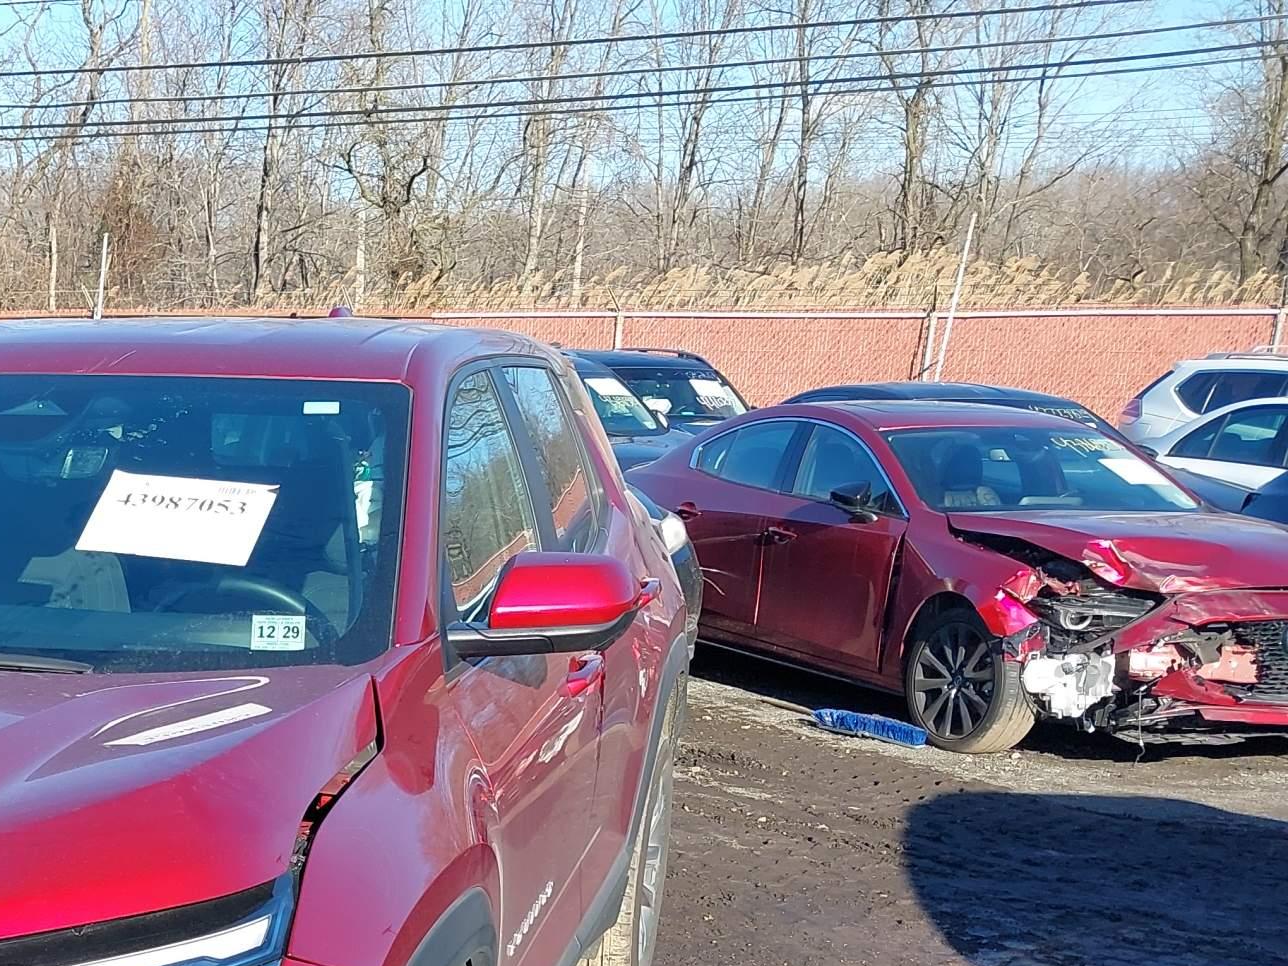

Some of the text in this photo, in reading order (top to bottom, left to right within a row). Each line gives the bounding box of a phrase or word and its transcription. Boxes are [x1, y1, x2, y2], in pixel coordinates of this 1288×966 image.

[117, 492, 247, 515] 43987053
[257, 625, 300, 639] 12 29
